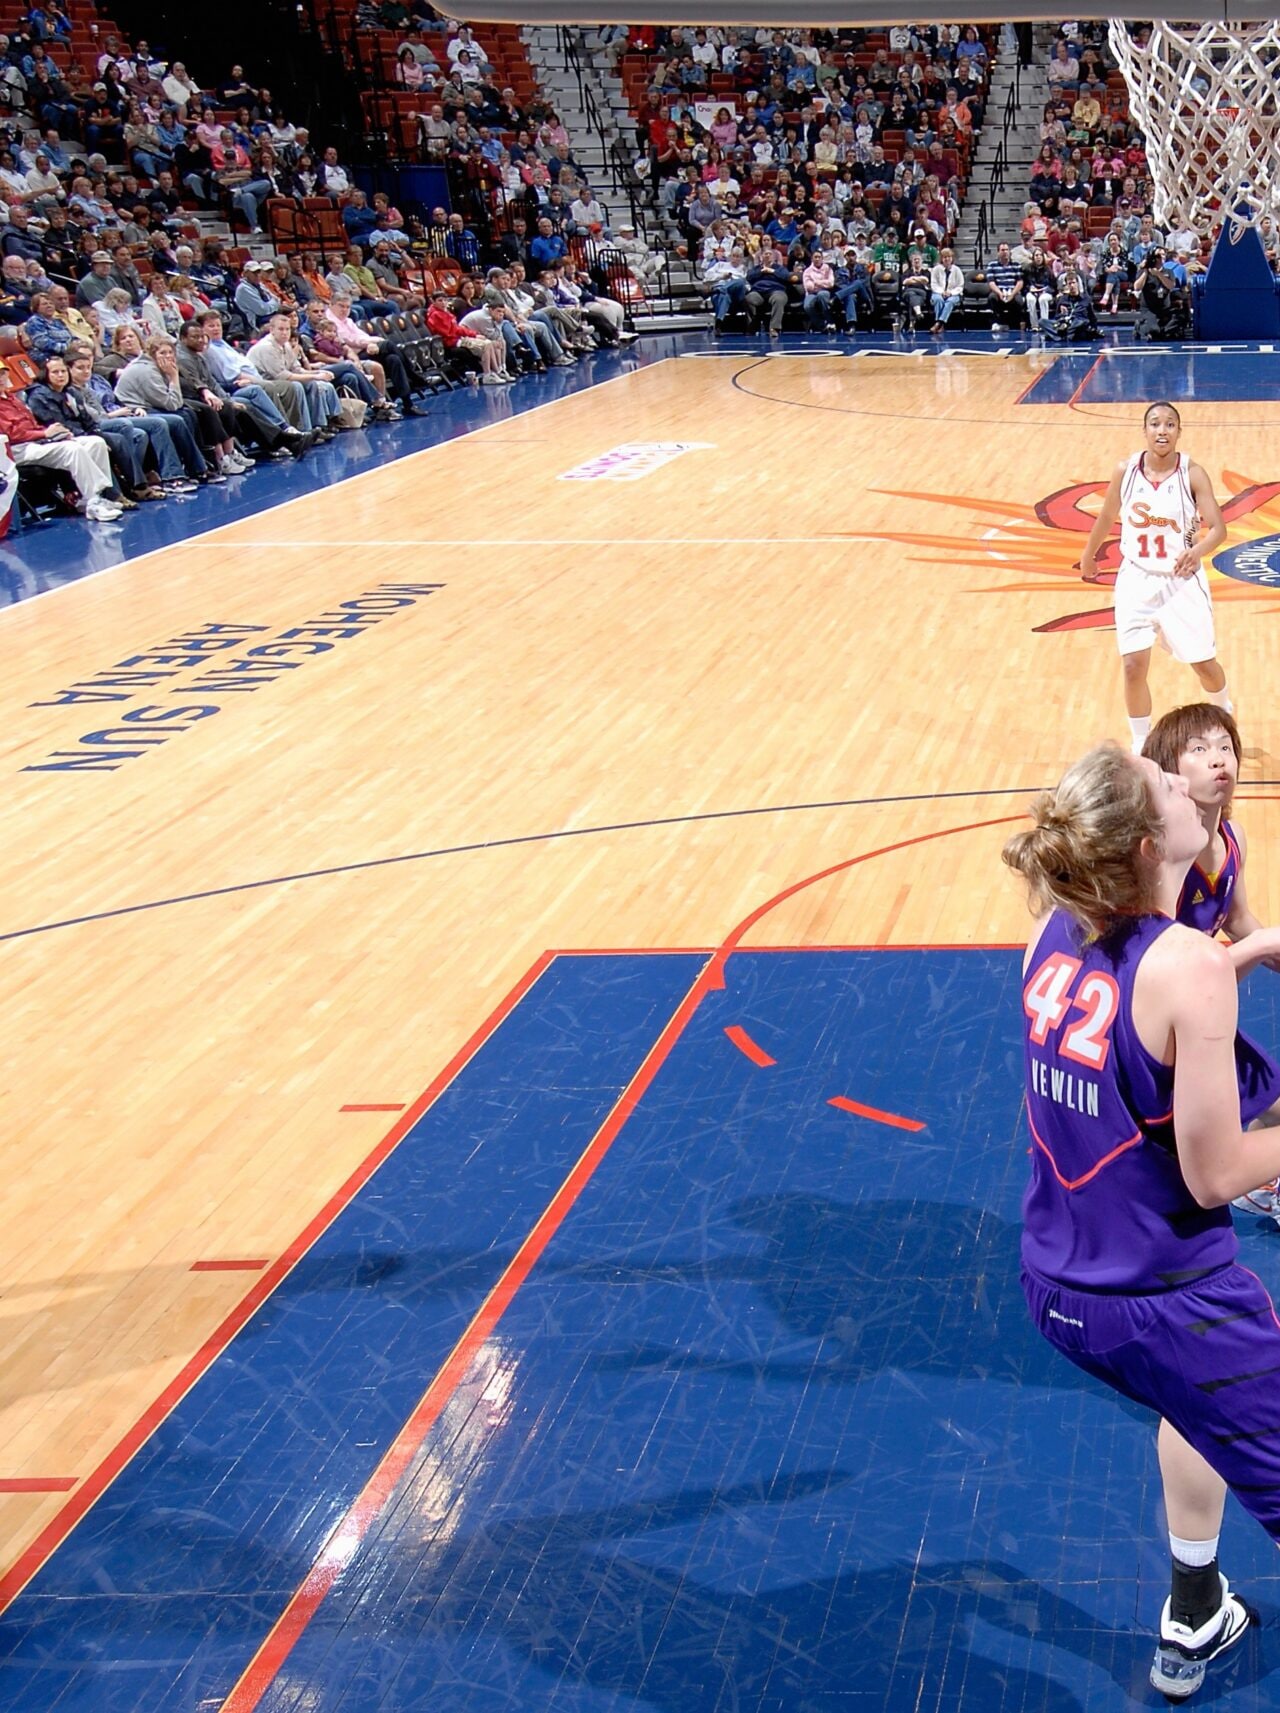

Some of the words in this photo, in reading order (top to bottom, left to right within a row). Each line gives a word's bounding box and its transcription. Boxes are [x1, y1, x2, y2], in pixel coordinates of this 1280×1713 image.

[1128, 501, 1182, 534] Sun
[1136, 534, 1168, 559] 11
[26, 622, 273, 709] ARENA
[169, 583, 448, 693] MOHEGAN
[16, 704, 222, 773] SUN
[1023, 951, 1121, 1072] 42
